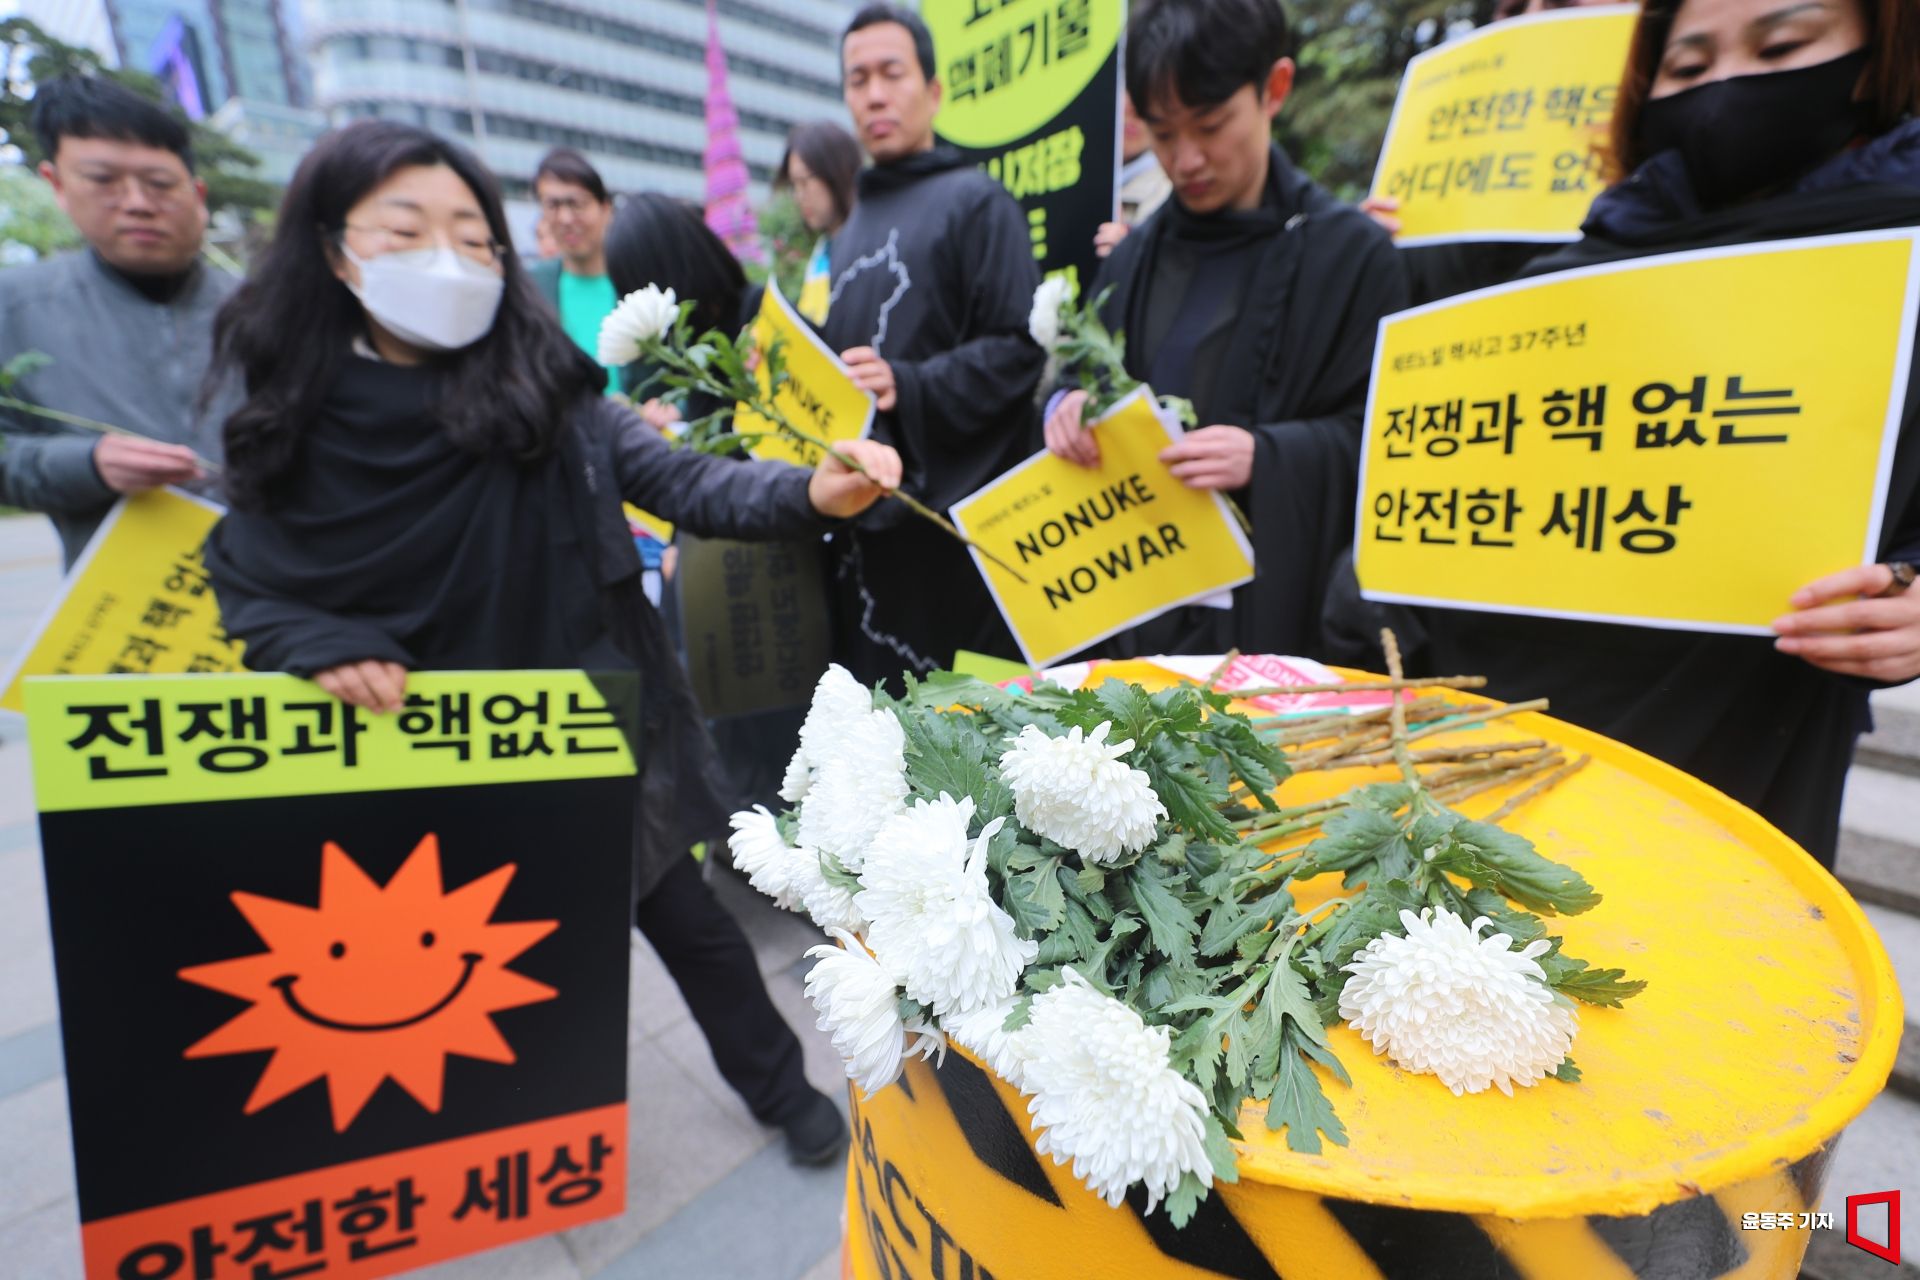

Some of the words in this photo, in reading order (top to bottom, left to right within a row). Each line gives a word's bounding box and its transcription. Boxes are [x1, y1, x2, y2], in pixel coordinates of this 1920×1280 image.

[1428, 87, 1535, 142] 안전한
[1387, 151, 1536, 202] 어디에도
[1509, 321, 1587, 352] 37주년
[1382, 393, 1524, 460] 전쟁과
[1541, 384, 1608, 452] 핵
[1631, 375, 1801, 450] 없는
[1014, 473, 1156, 564] NONUKE
[1373, 487, 1523, 548] 안전한
[1539, 484, 1693, 555] 세상
[1042, 521, 1188, 611] NOWAR
[67, 696, 368, 780] 전쟁과
[115, 1175, 427, 1280] 안전한
[449, 1133, 615, 1223] 세상
